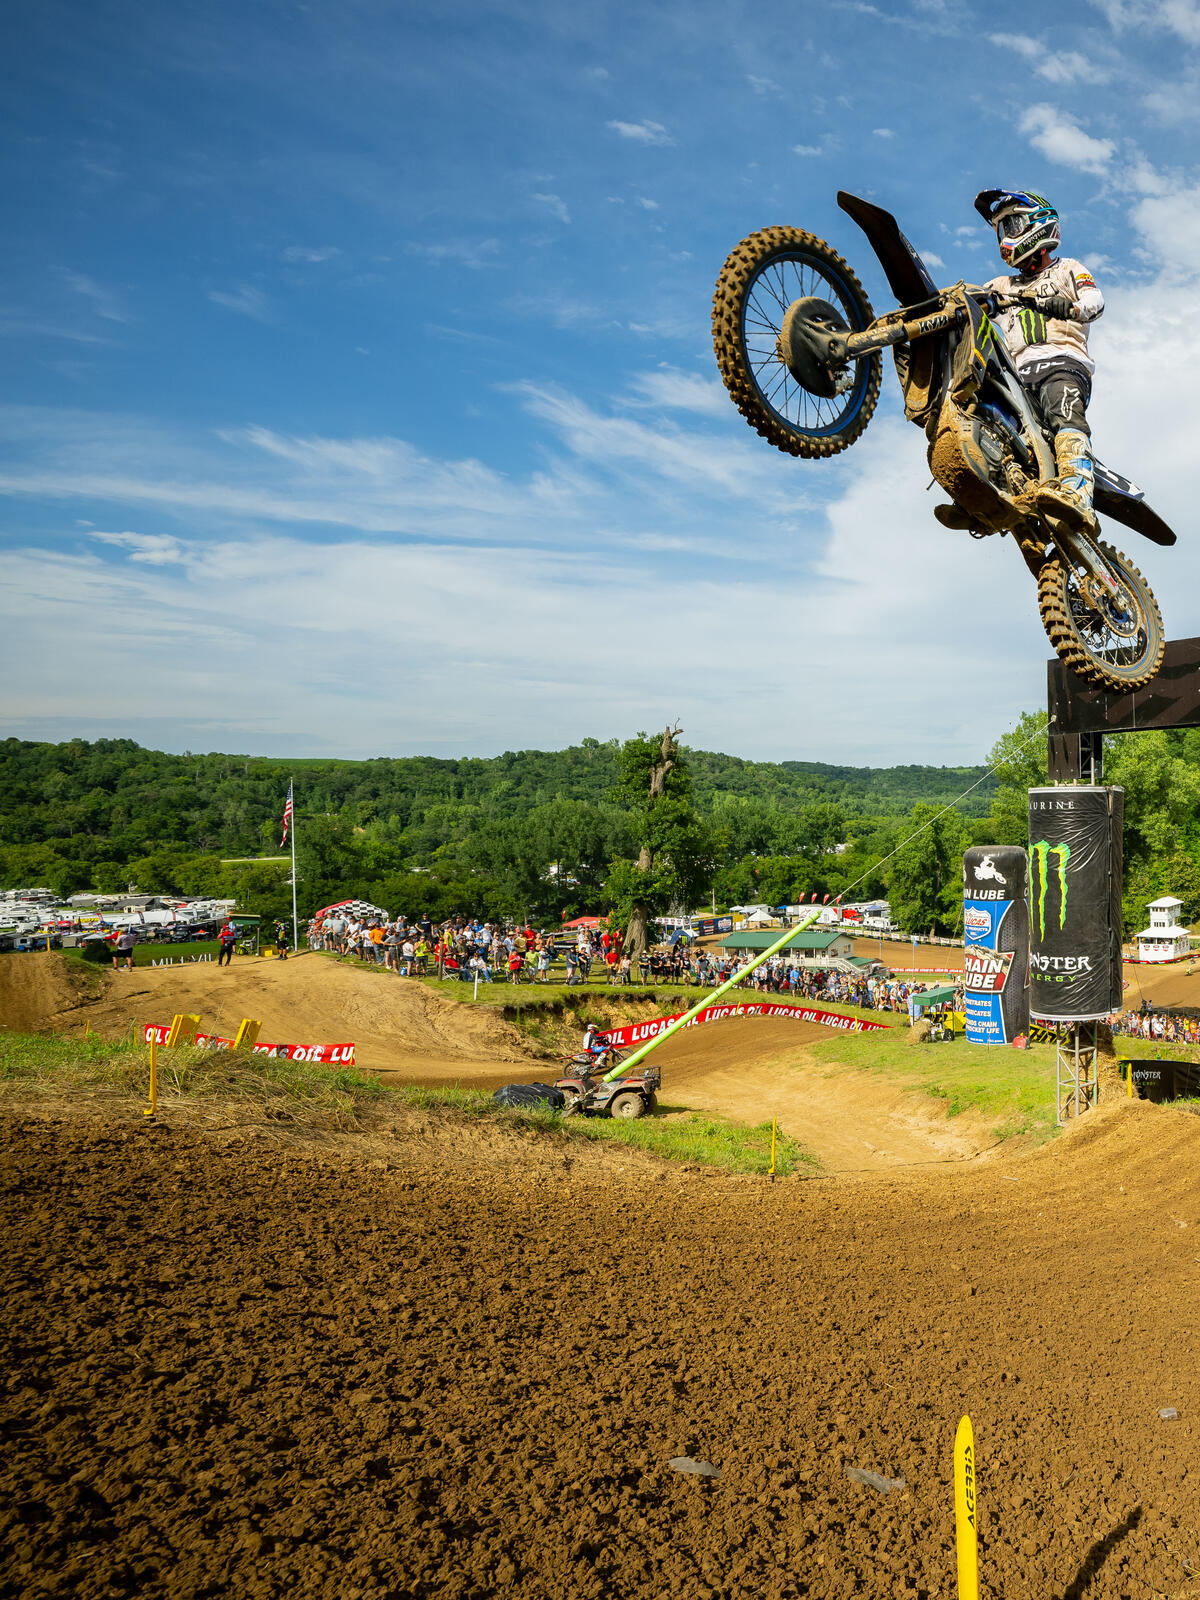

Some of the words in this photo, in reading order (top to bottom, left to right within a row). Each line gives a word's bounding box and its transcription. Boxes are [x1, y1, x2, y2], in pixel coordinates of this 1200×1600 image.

[973, 889, 1006, 900] LUBE
[965, 958, 1003, 974] HAIN
[965, 974, 997, 989] UBE
[802, 1010, 817, 1023] OIL
[820, 1014, 850, 1029] LUCAS
[632, 1018, 675, 1041] LUCAS
[964, 1445, 976, 1529] ACERBIS
